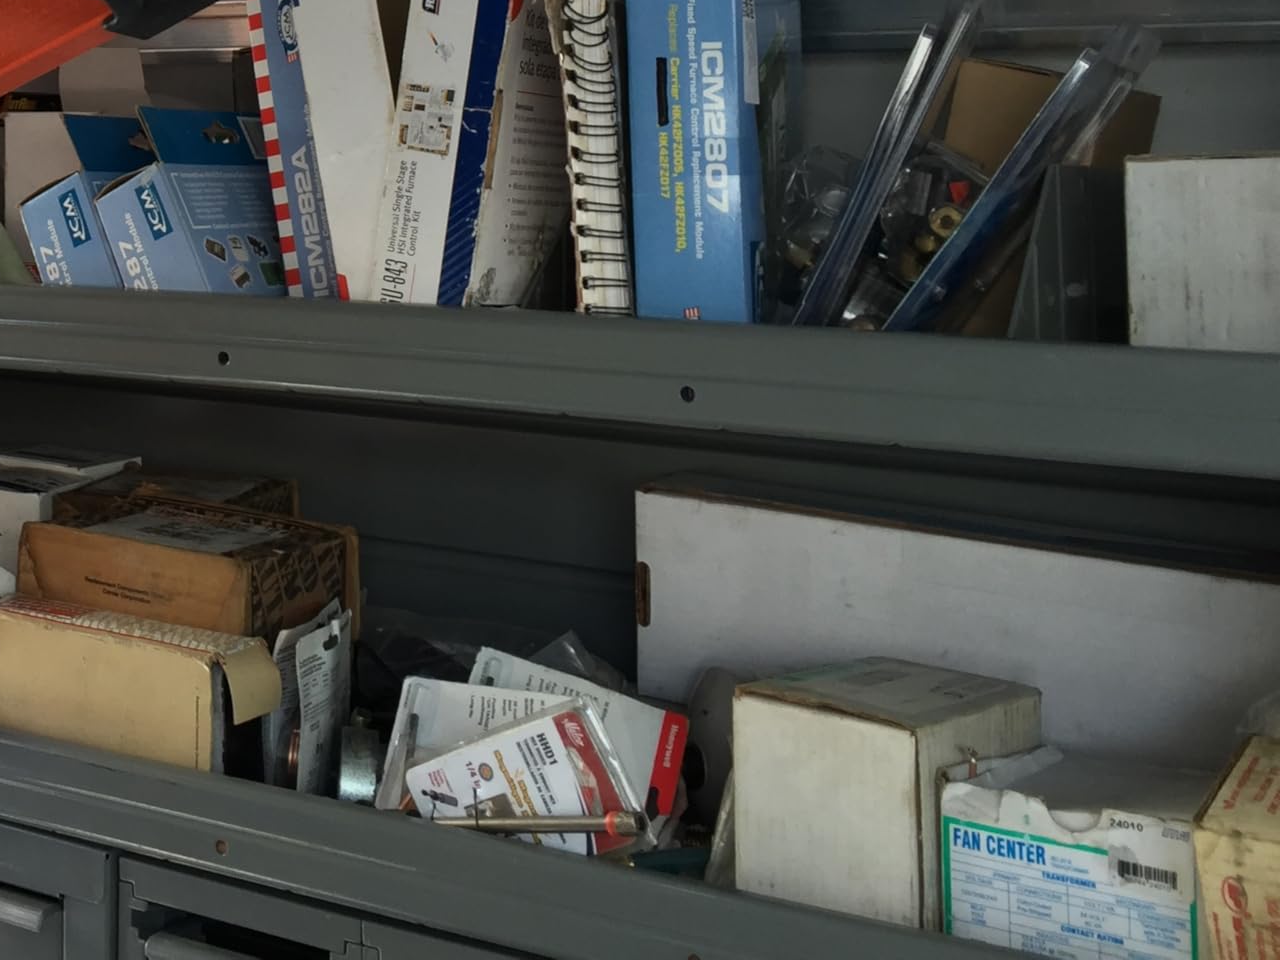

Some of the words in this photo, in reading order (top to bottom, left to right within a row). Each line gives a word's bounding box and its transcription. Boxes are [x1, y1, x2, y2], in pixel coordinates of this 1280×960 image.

[687, 28, 698, 60] Speed
[670, 57, 680, 100] Carrier
[689, 62, 698, 104] Furnace
[671, 106, 684, 177] HK42FZ005,
[691, 107, 700, 148] Control
[701, 40, 729, 214] ICM2807
[397, 160, 406, 185] Stage
[658, 132, 669, 198] HK42FZ017
[691, 151, 702, 217] Replacement
[392, 185, 403, 212] Single
[400, 195, 412, 238] Integrated
[408, 160, 417, 193] Furnace
[412, 210, 420, 222] Kit
[674, 182, 687, 252] HK42FZ010,
[47, 219, 63, 258] Module
[125, 213, 144, 253] Module
[294, 144, 328, 297] ICM282A
[387, 213, 397, 253] Universal
[407, 225, 418, 256] Control
[695, 221, 704, 259] Module
[40, 246, 63, 285] 87
[119, 242, 147, 291] 287
[537, 733, 558, 766] HHD1
[1109, 817, 1144, 832] 24010
[953, 828, 981, 851] FAN
[986, 835, 1047, 866] CENTER
